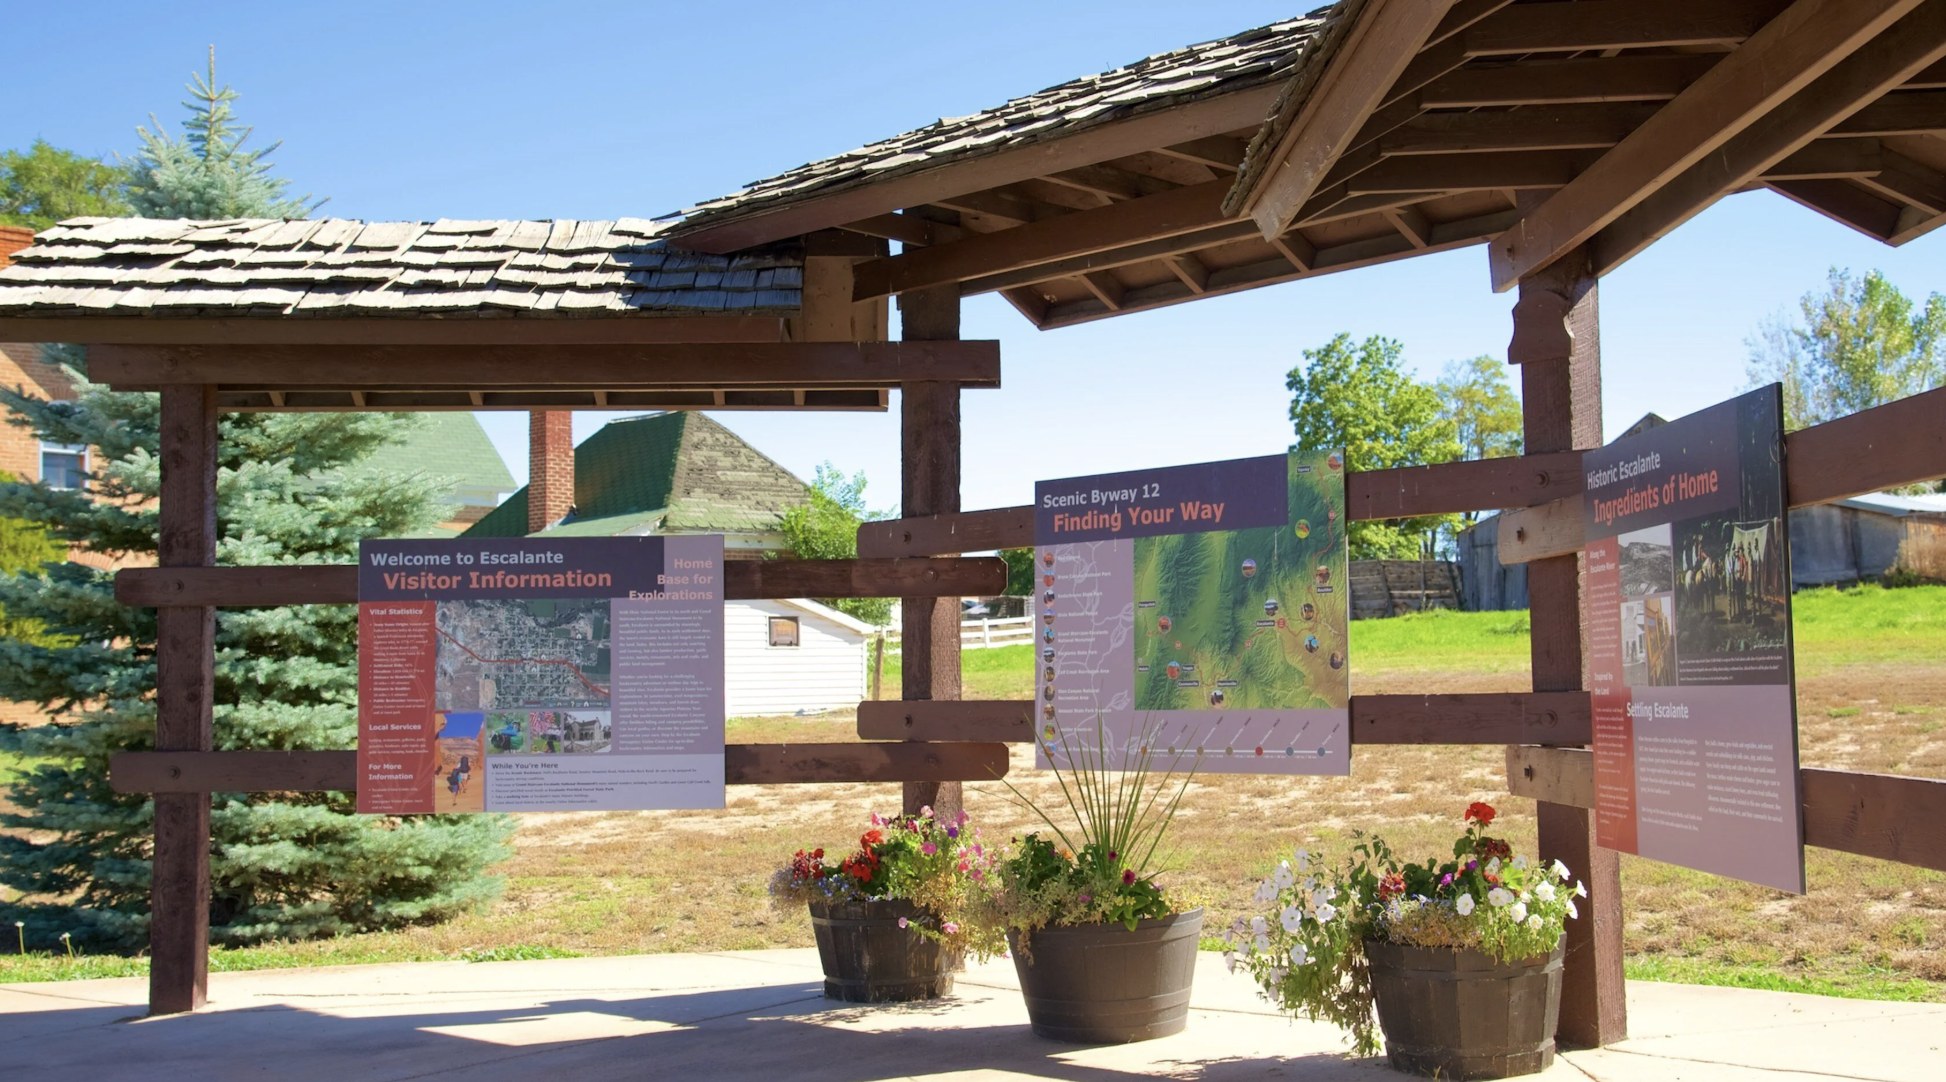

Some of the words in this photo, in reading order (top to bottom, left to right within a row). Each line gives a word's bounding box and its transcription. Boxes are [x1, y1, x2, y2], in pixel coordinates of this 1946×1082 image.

[1587, 465, 1618, 490] Historic
[1619, 451, 1661, 480] Escalante
[1043, 491, 1087, 508] Scenic
[1091, 488, 1137, 506] Byway
[1143, 483, 1160, 498] 12
[1594, 484, 1659, 526] Ingredients
[1662, 474, 1675, 505] of
[1679, 469, 1718, 500] Home
[1053, 511, 1122, 532] Finding
[1128, 507, 1174, 526] Your
[1180, 501, 1225, 523] Way
[370, 553, 450, 566] Welcome
[456, 552, 474, 565] to
[480, 550, 564, 564] Escalante
[674, 558, 713, 569] Home
[384, 571, 462, 589] Visitor
[469, 570, 612, 589] Information
[657, 574, 689, 584] Base
[694, 573, 713, 584] for
[629, 589, 713, 602] Explorations
[1626, 702, 1653, 721] Settling
[1654, 702, 1689, 718] Escalante
